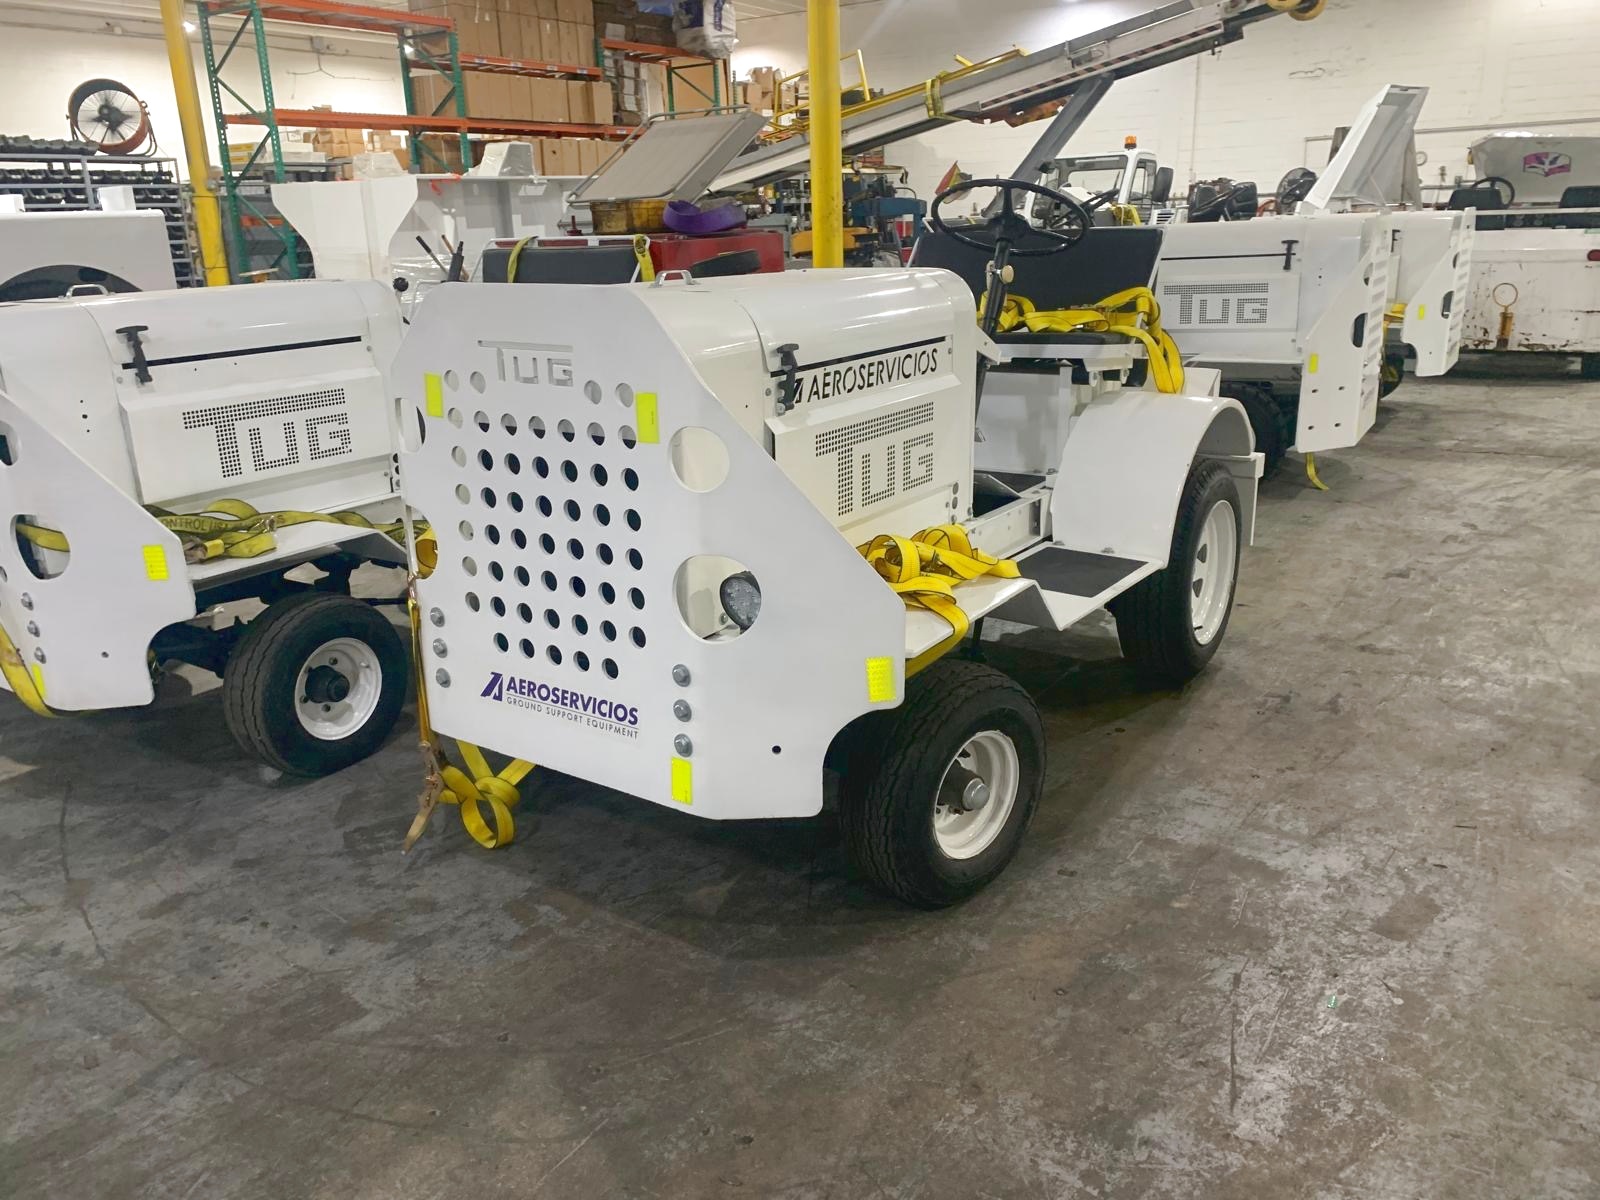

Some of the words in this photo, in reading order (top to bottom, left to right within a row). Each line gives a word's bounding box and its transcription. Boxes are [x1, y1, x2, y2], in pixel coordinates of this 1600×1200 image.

[1163, 283, 1269, 325] TUG
[477, 339, 574, 388] TUG
[807, 348, 938, 403] AEROSERVICIOS
[182, 388, 353, 479] TUG
[815, 401, 934, 517] TUG
[506, 676, 639, 726] AEROSERVICIOS
[506, 696, 543, 713] GROUND
[546, 706, 583, 724] SUPPORT
[586, 718, 639, 739] EQUIPMENT
